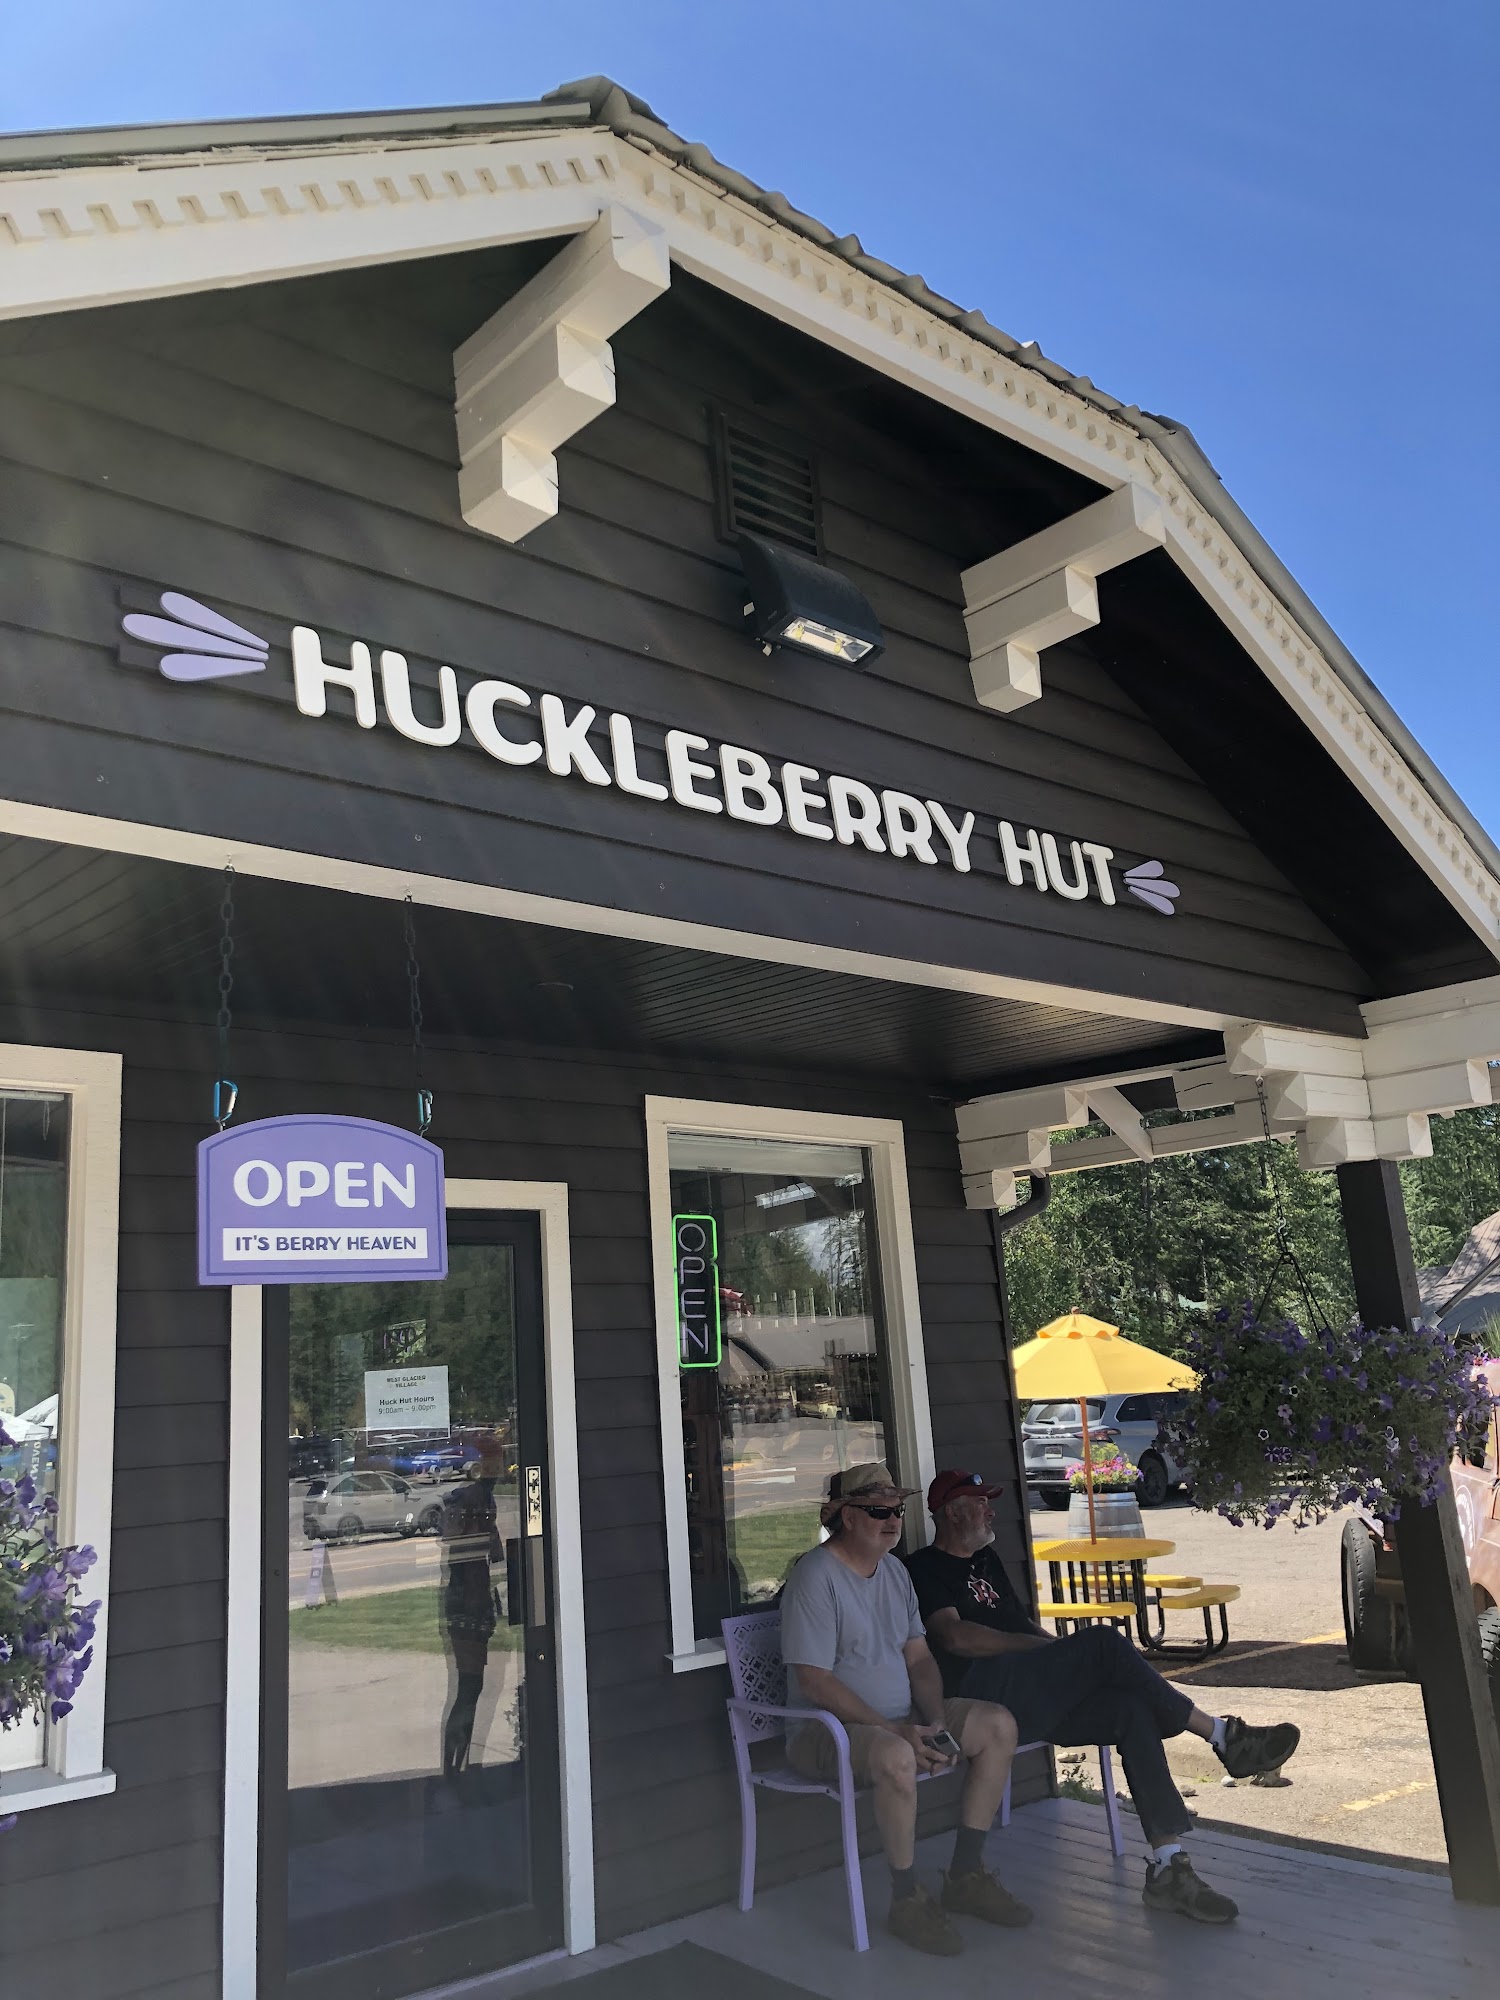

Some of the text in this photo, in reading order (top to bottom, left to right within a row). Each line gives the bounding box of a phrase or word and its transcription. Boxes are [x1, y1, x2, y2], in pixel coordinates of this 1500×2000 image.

[291, 625, 1116, 906] HUCKLEBERRY HUT
[234, 1160, 416, 1209] OPEN
[235, 1234, 416, 1251] IT'S BERRY HEAVEN
[677, 1222, 709, 1358] OPEN
